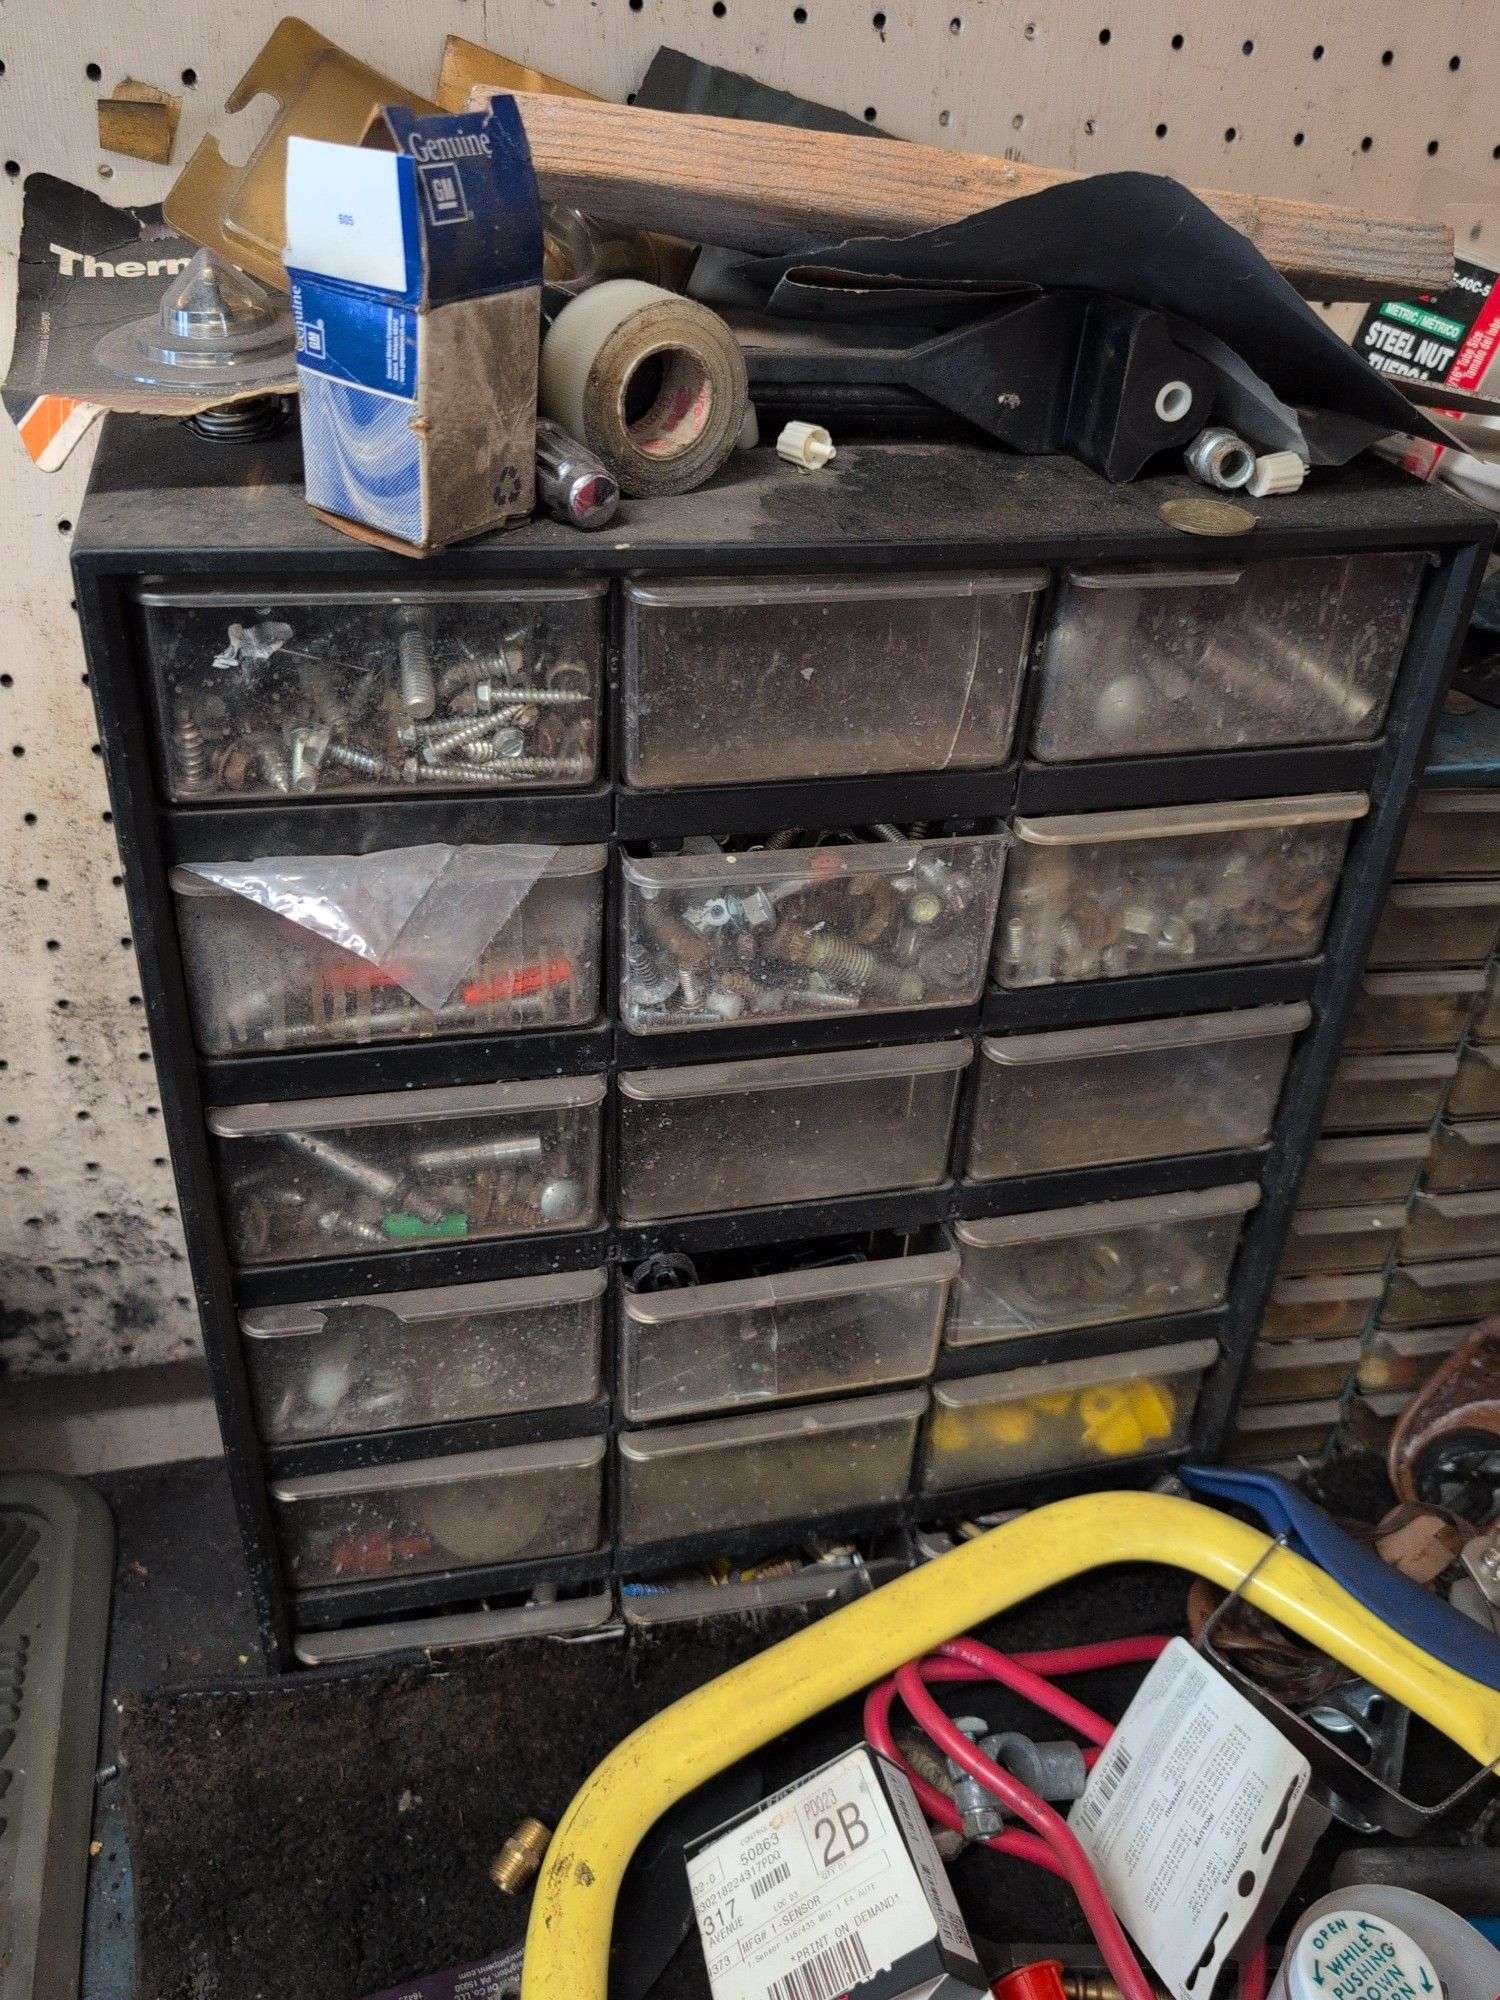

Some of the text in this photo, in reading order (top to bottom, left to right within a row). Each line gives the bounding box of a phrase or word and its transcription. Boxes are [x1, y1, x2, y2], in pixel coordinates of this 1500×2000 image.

[408, 130, 493, 162] Genuine
[1385, 302, 1418, 323] METRIC
[1365, 321, 1456, 372] STEEL NUT
[741, 1832, 779, 1866] 50863
[815, 1802, 869, 1867] 2B
[1222, 1841, 1248, 1885] CONTENTS
[703, 1898, 735, 1936] 317
[710, 1917, 744, 1948] AVENUE
[834, 1922, 850, 1939] ON
[1312, 1918, 1348, 1950] OPEN
[1326, 1933, 1373, 1976] WHILE
[1332, 1941, 1396, 2000] PUSHING
